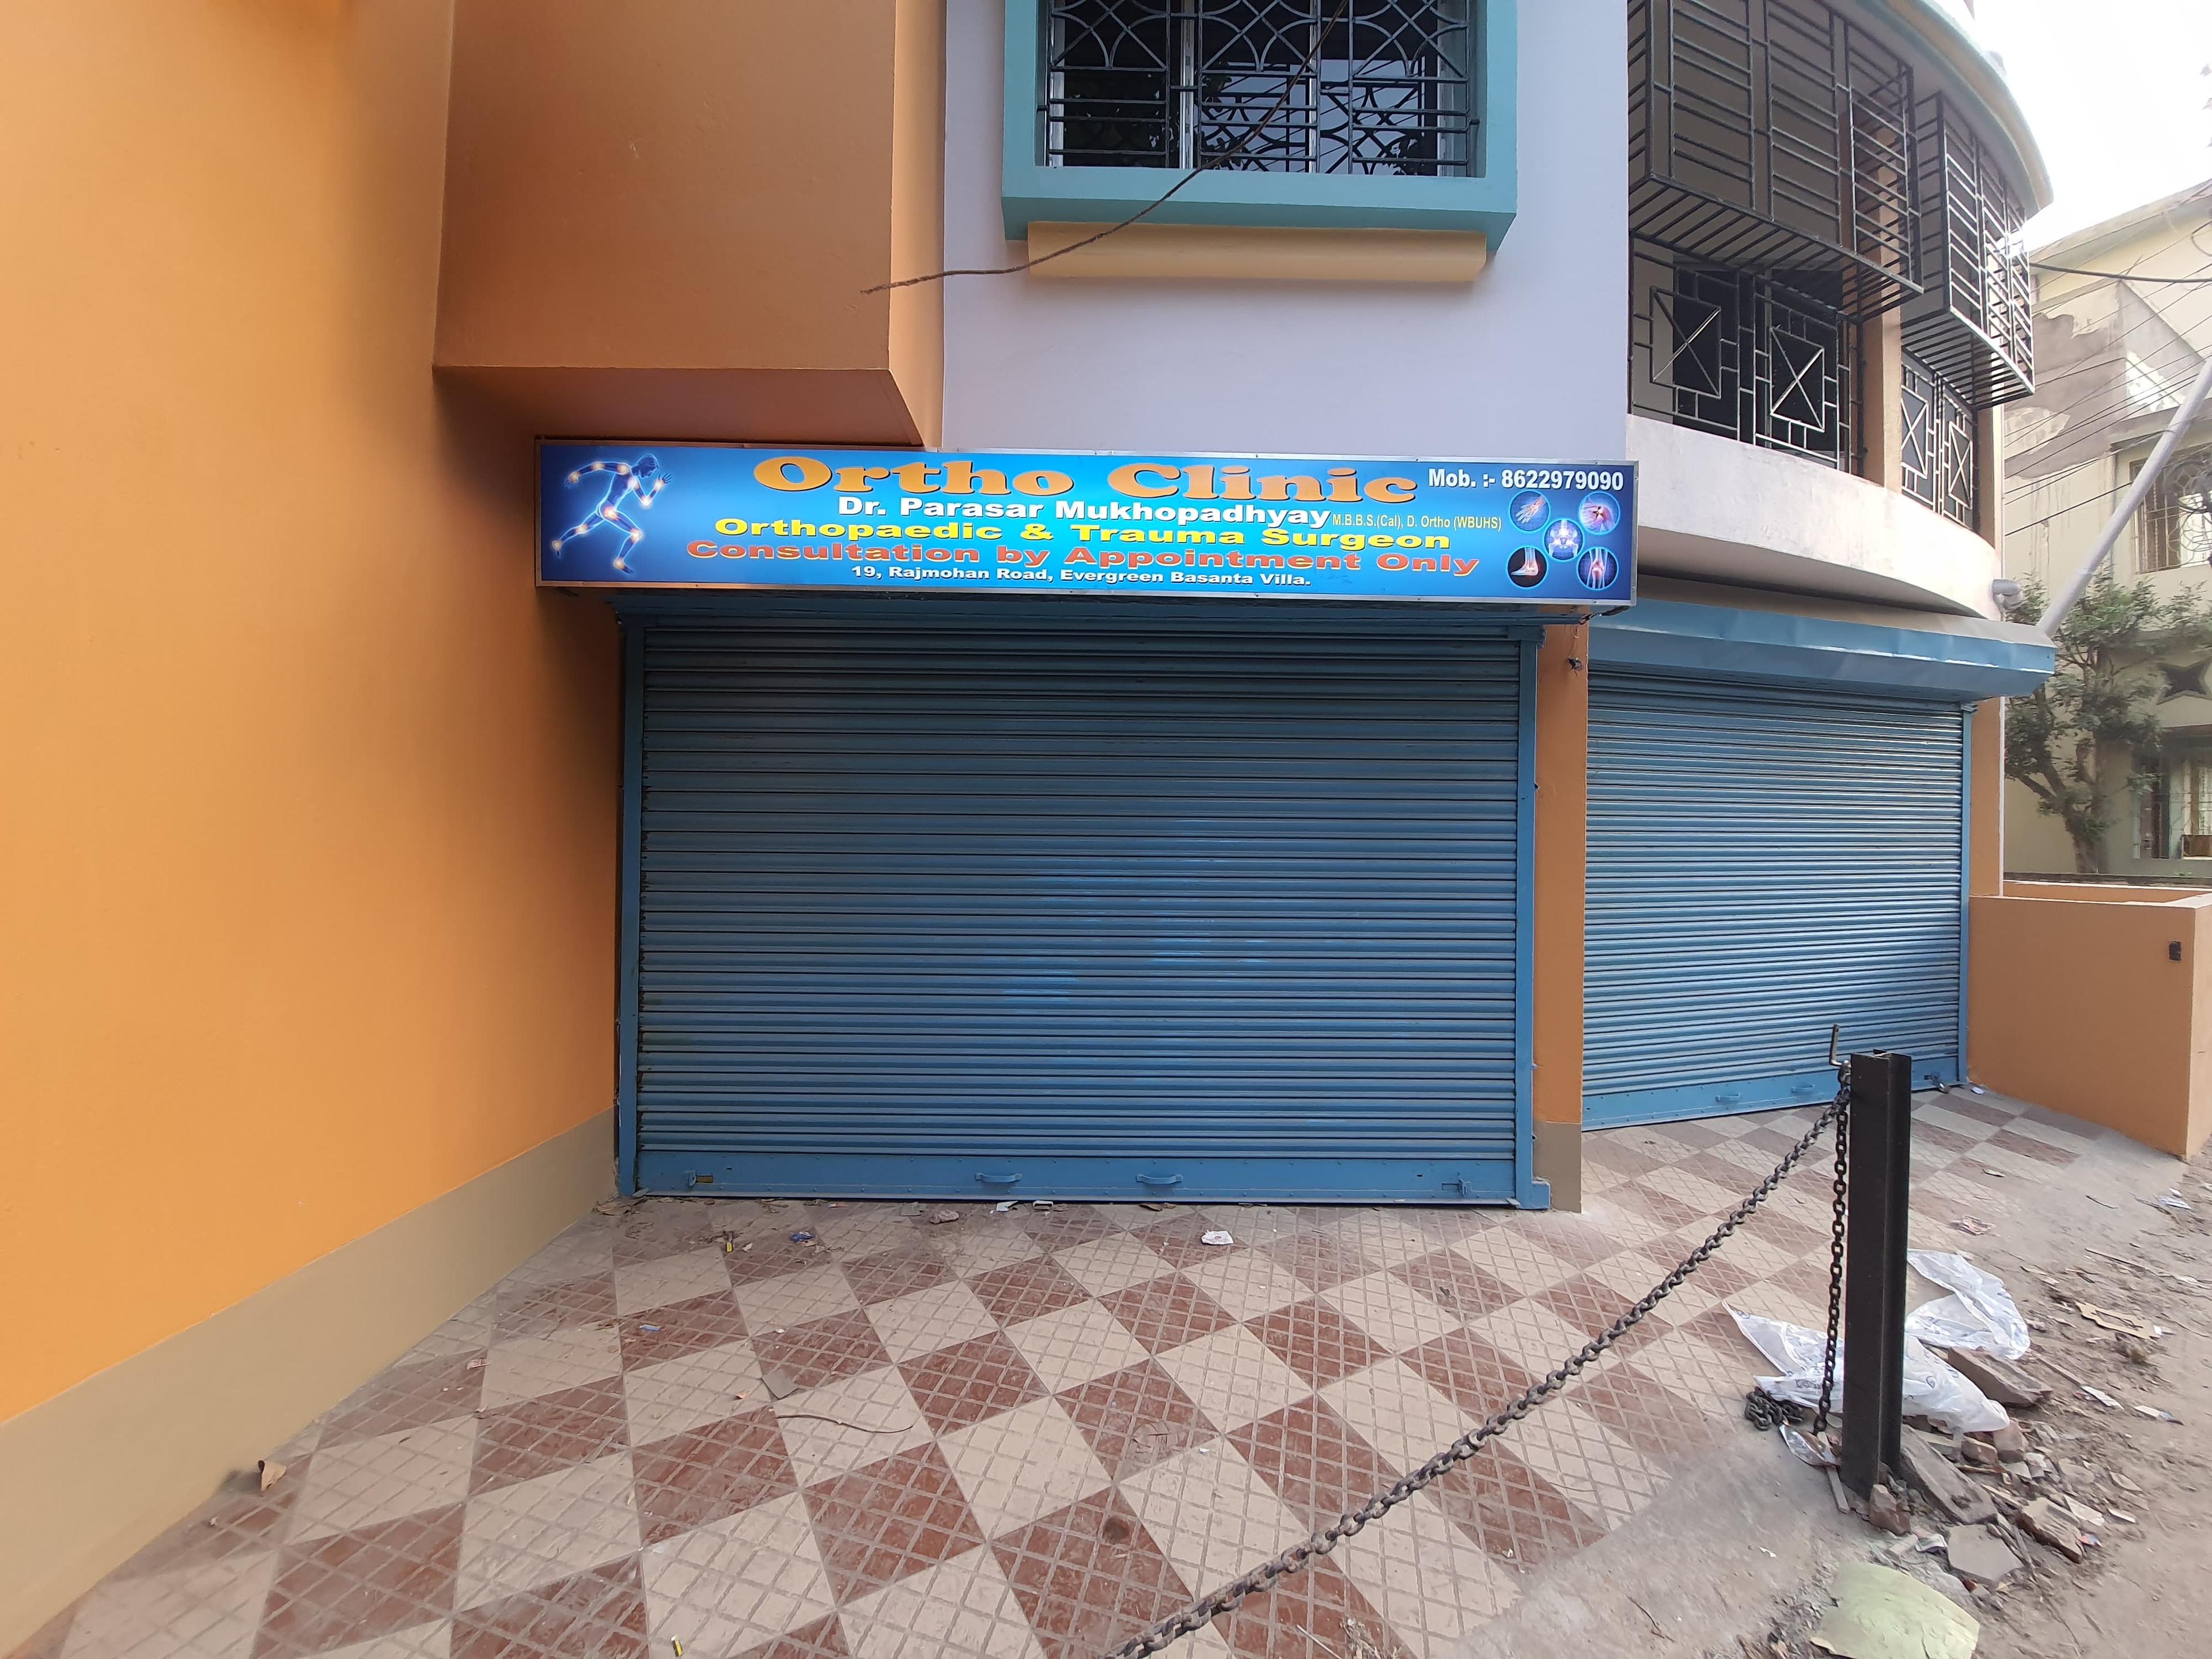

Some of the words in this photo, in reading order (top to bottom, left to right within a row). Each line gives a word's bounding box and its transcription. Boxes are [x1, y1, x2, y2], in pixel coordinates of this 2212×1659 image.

[753, 456, 1074, 496] Ortho
[1108, 463, 1417, 503] Clinic
[1429, 468, 1476, 488] Mob.
[1501, 469, 1623, 490] 8622979090
[839, 496, 887, 516] Dr.
[900, 497, 1044, 518] Parasar
[1055, 500, 1331, 529] Mukhopadhyay
[1407, 517, 1418, 527] D.
[1421, 516, 1450, 528] Ortho
[1453, 516, 1502, 531] (WBUHS)
[715, 518, 1002, 541] Orthopaedic
[1021, 524, 1054, 540] &
[1071, 525, 1244, 545] Trauma
[1261, 529, 1450, 551] Surgeon
[687, 540, 980, 562] Consultation
[997, 546, 1051, 567] by
[1064, 547, 1361, 570] Appointment
[1377, 554, 1479, 576] Only
[852, 566, 882, 579] 19,
[889, 567, 990, 581] Rajmohan
[997, 568, 1054, 584] Road,
[1061, 570, 1164, 585] Evergreen
[1171, 571, 1253, 585] Basanta
[1260, 574, 1311, 585] Villa.
